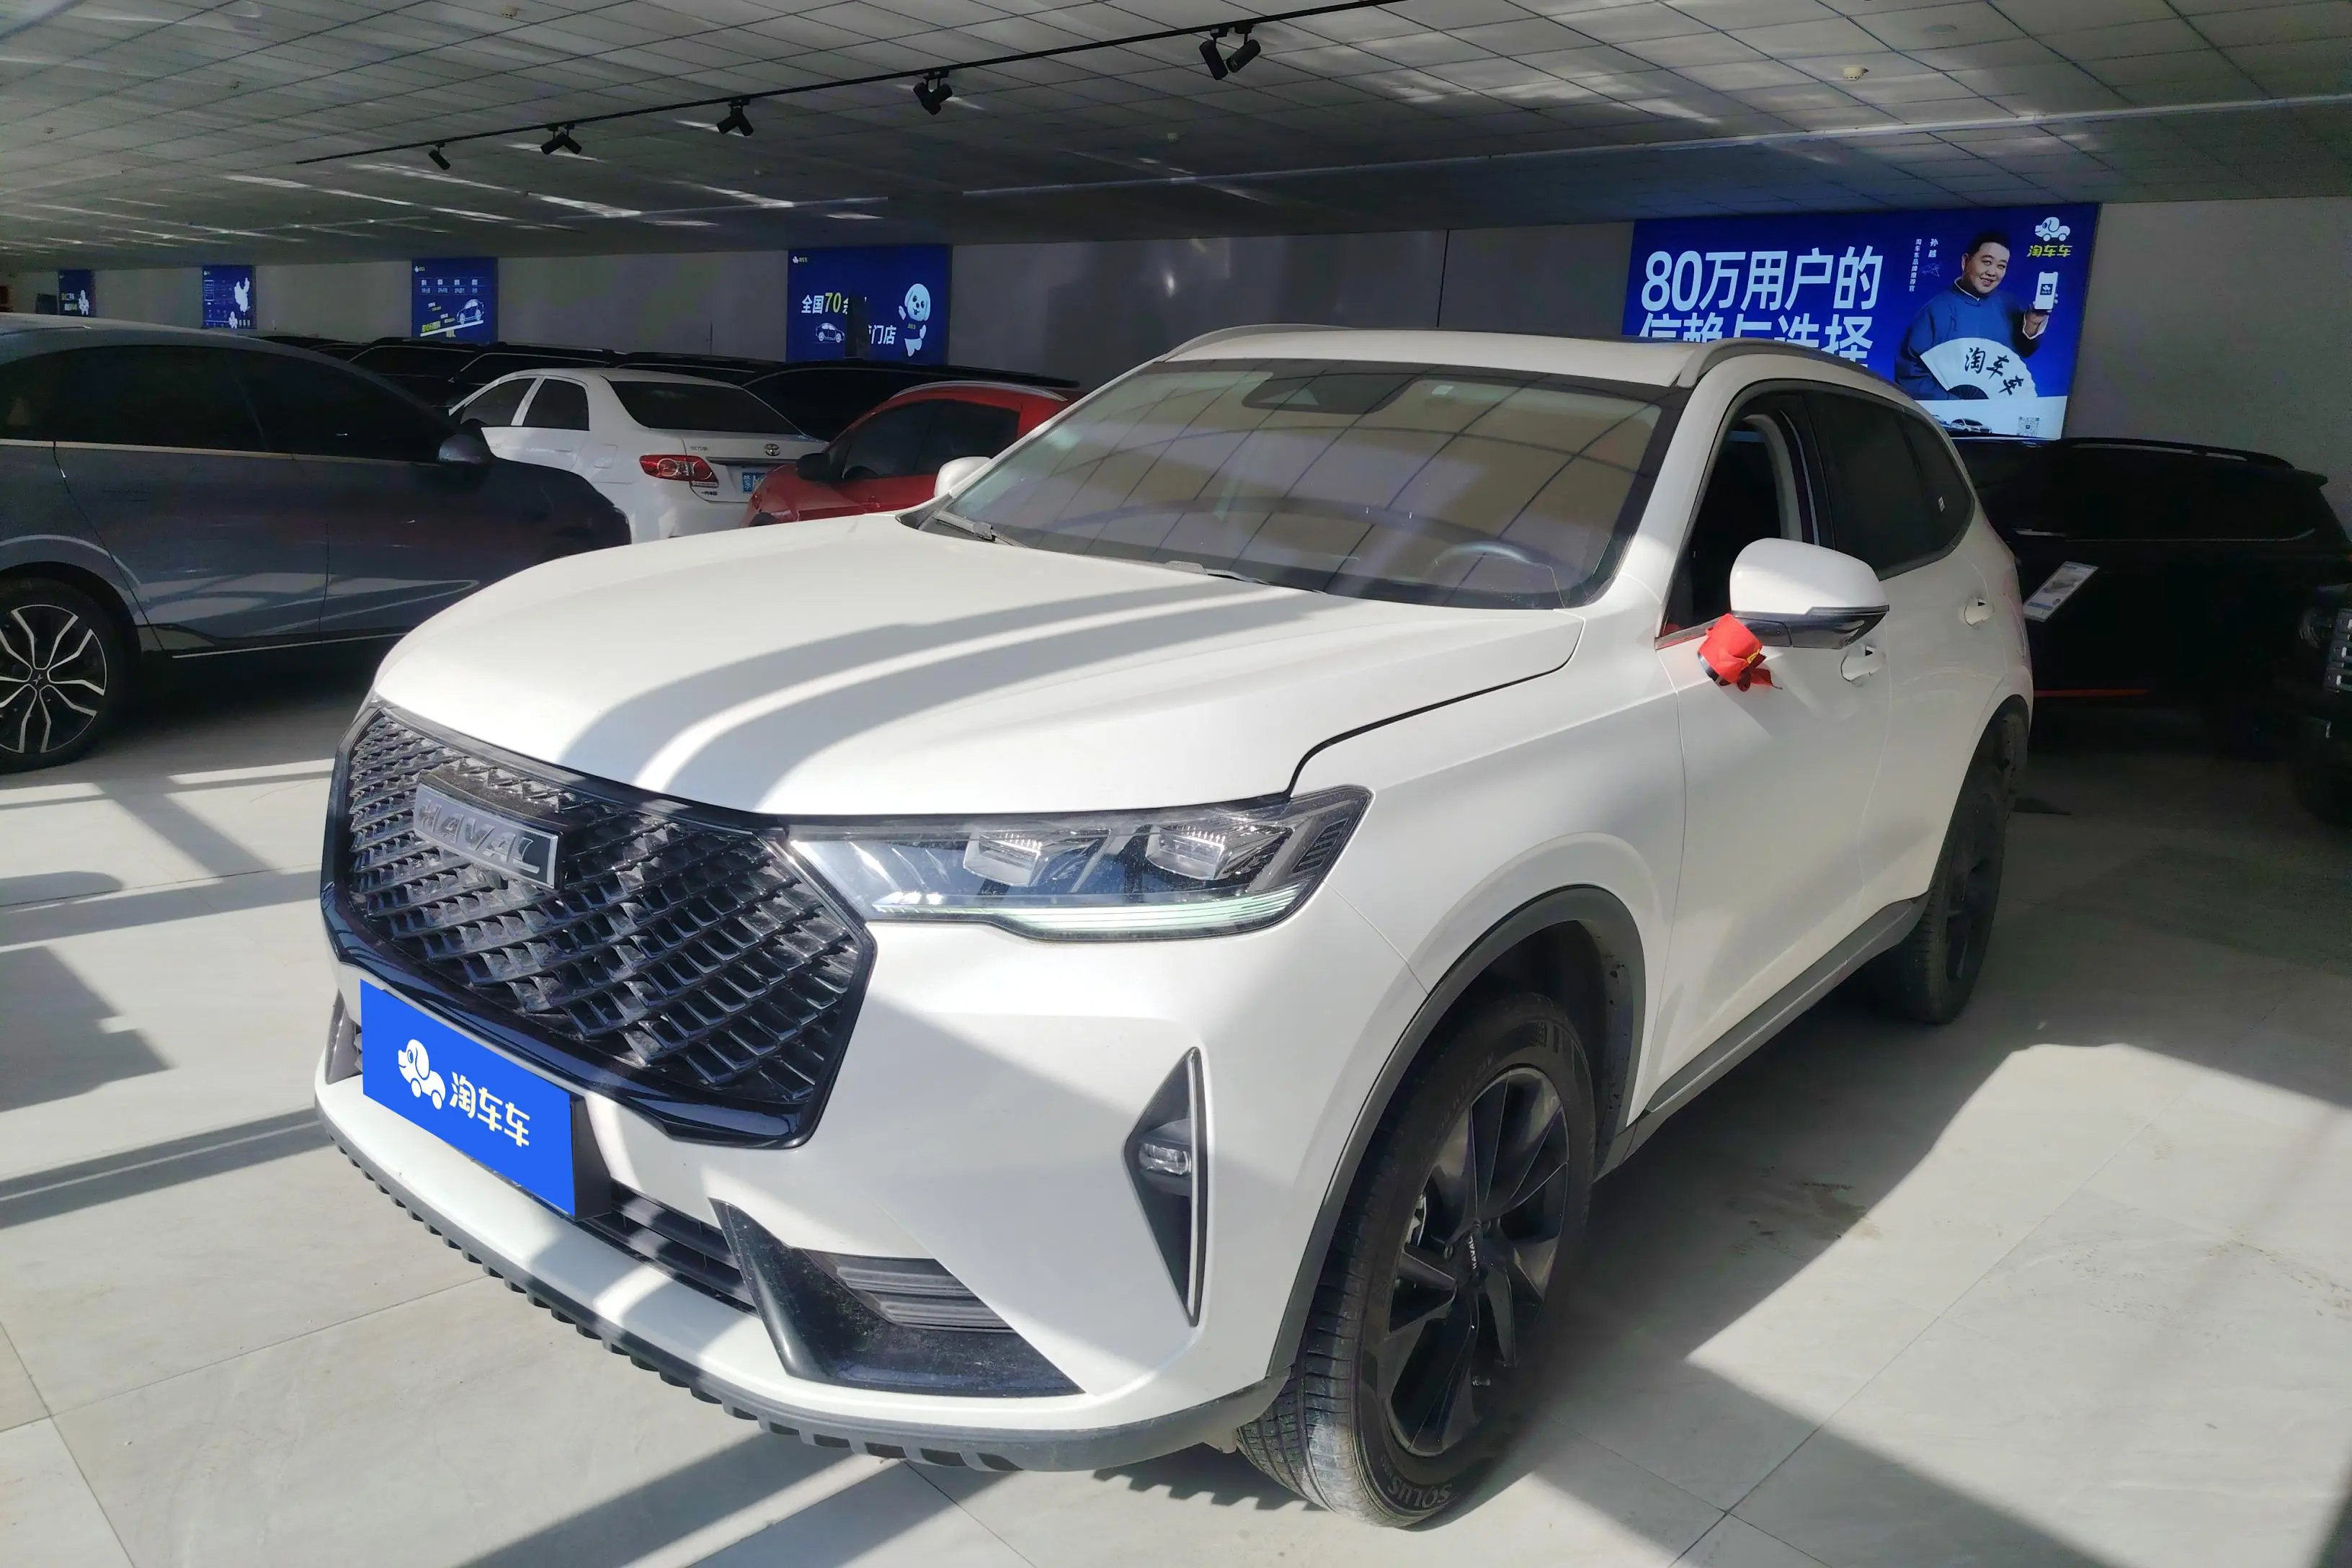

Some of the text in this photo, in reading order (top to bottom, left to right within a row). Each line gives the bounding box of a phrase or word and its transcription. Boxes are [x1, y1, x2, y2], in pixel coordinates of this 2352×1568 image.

[2026, 244, 2073, 257] 淘车车
[1641, 245, 1883, 311] 80万用户的
[868, 324, 897, 344] 门店
[1964, 347, 2024, 396] 淘车车
[419, 798, 540, 874] HAVAL
[1468, 1235, 1477, 1270] HAVAL
